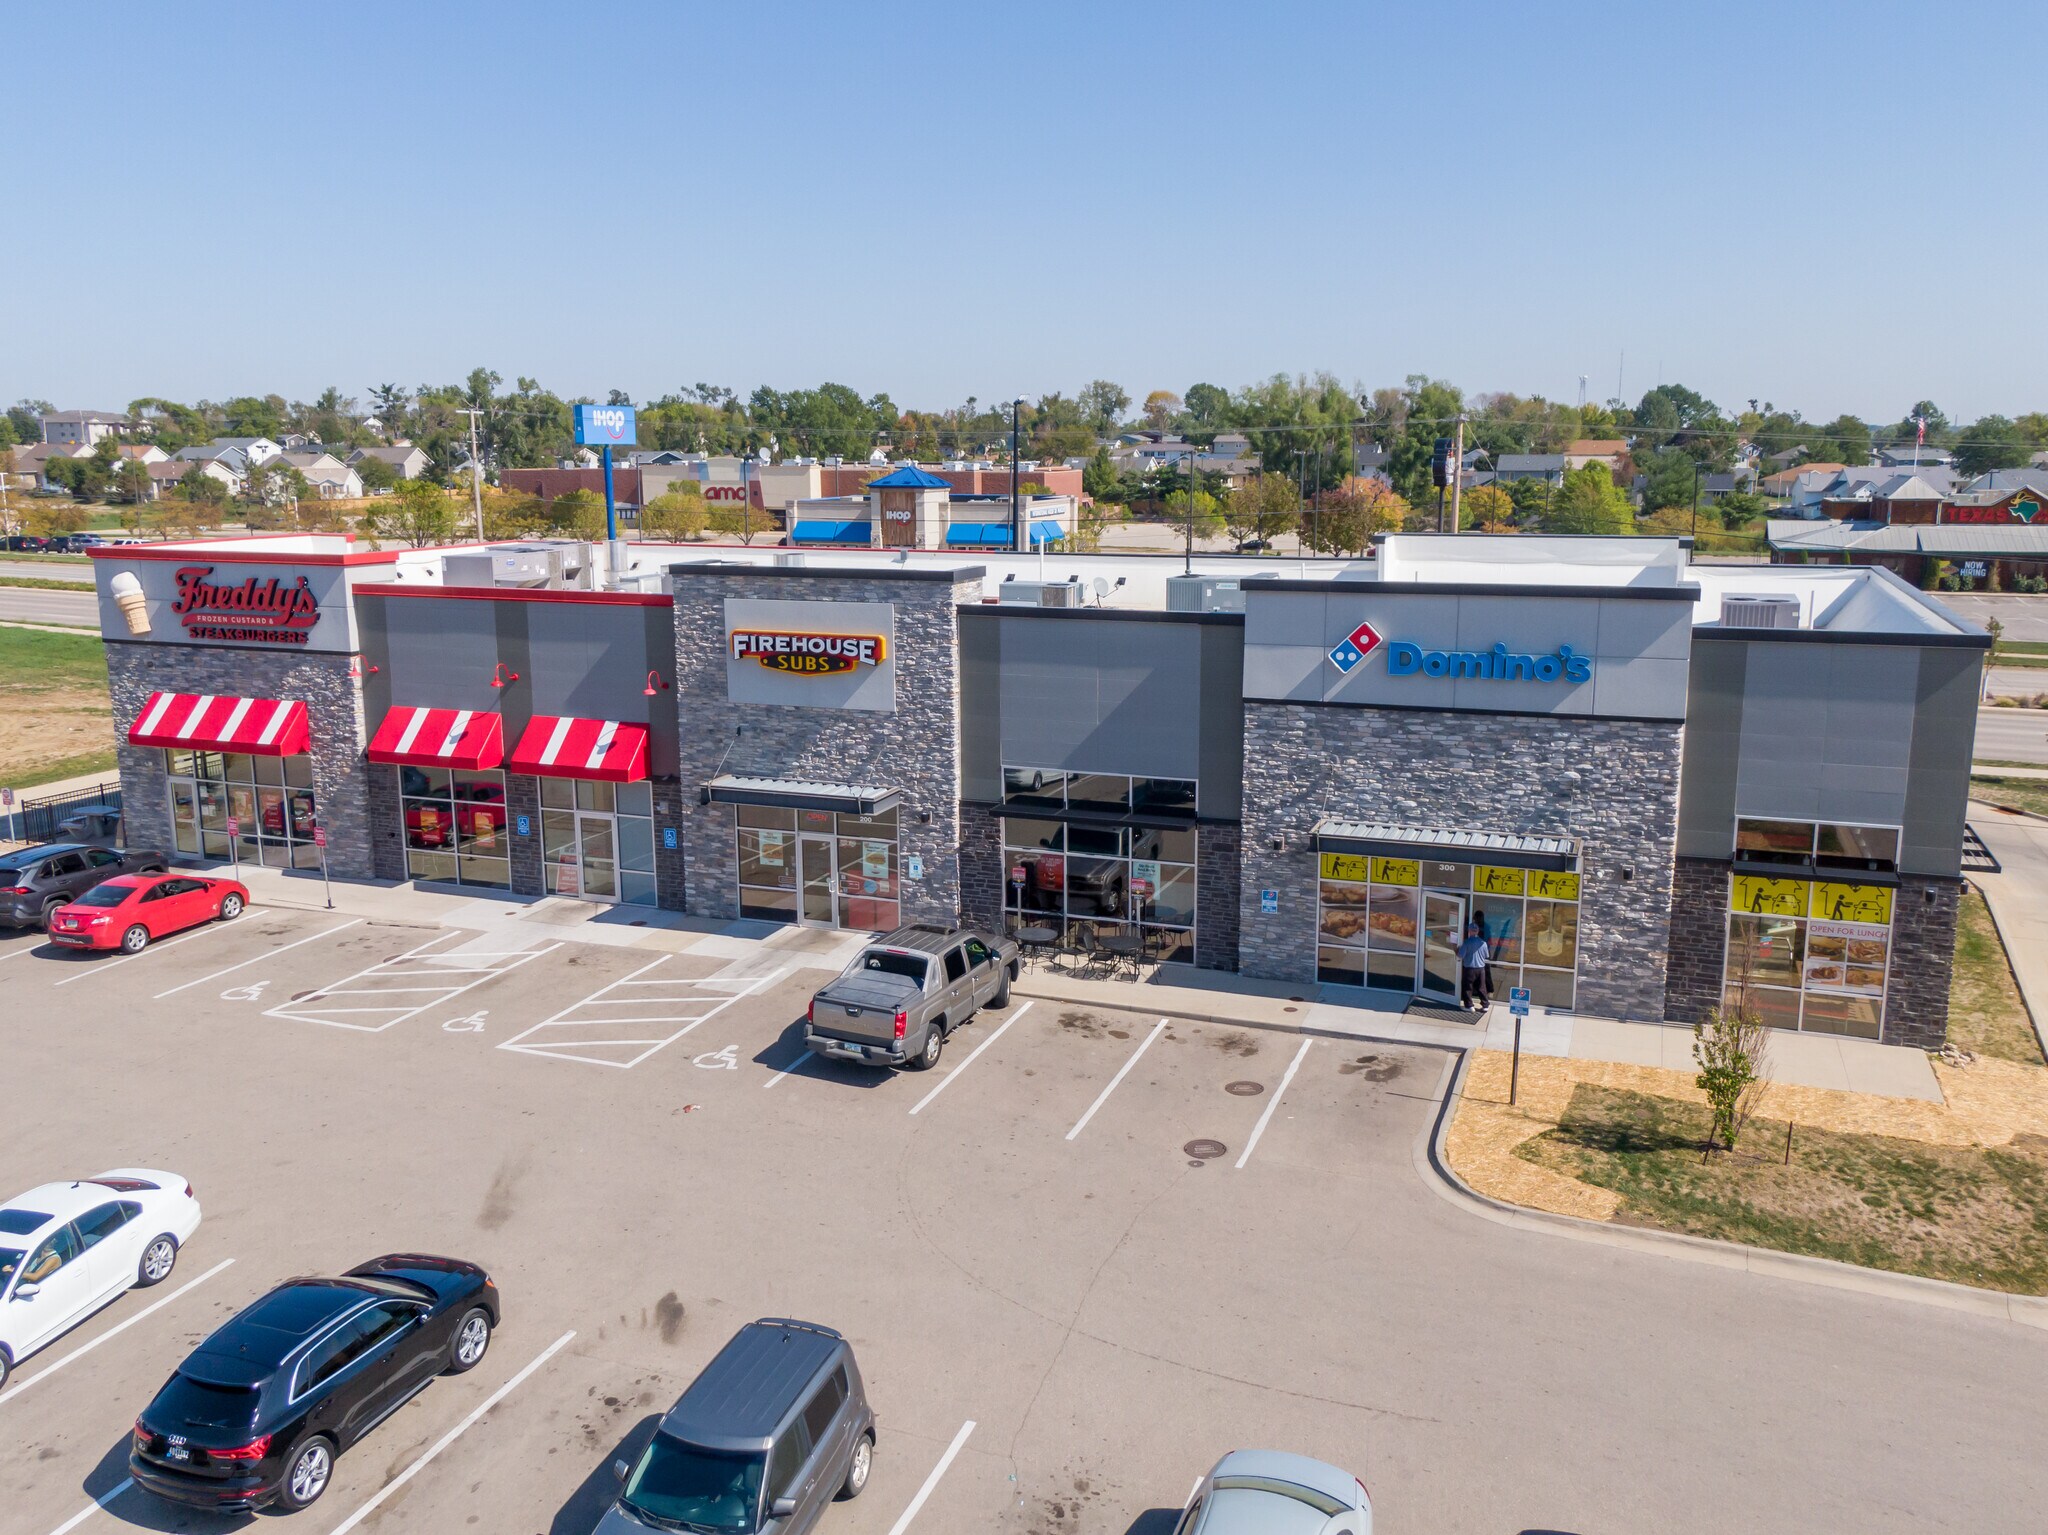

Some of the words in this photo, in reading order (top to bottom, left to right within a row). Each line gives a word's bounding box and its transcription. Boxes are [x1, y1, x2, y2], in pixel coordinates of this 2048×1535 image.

[1948, 507, 2007, 522] TEXAS
[1960, 568, 1986, 576] HIRING
[1965, 561, 1984, 570] NOW
[171, 566, 318, 627] Freddy's
[197, 615, 228, 623] FROZEN
[189, 627, 309, 644] STEAKBURGERS
[733, 635, 876, 666] FIREHOUSE
[777, 655, 830, 671] SUBS
[1387, 641, 1592, 684] Domino's
[1810, 925, 1835, 933] OPEN
[1857, 930, 1889, 938] LUNCH
